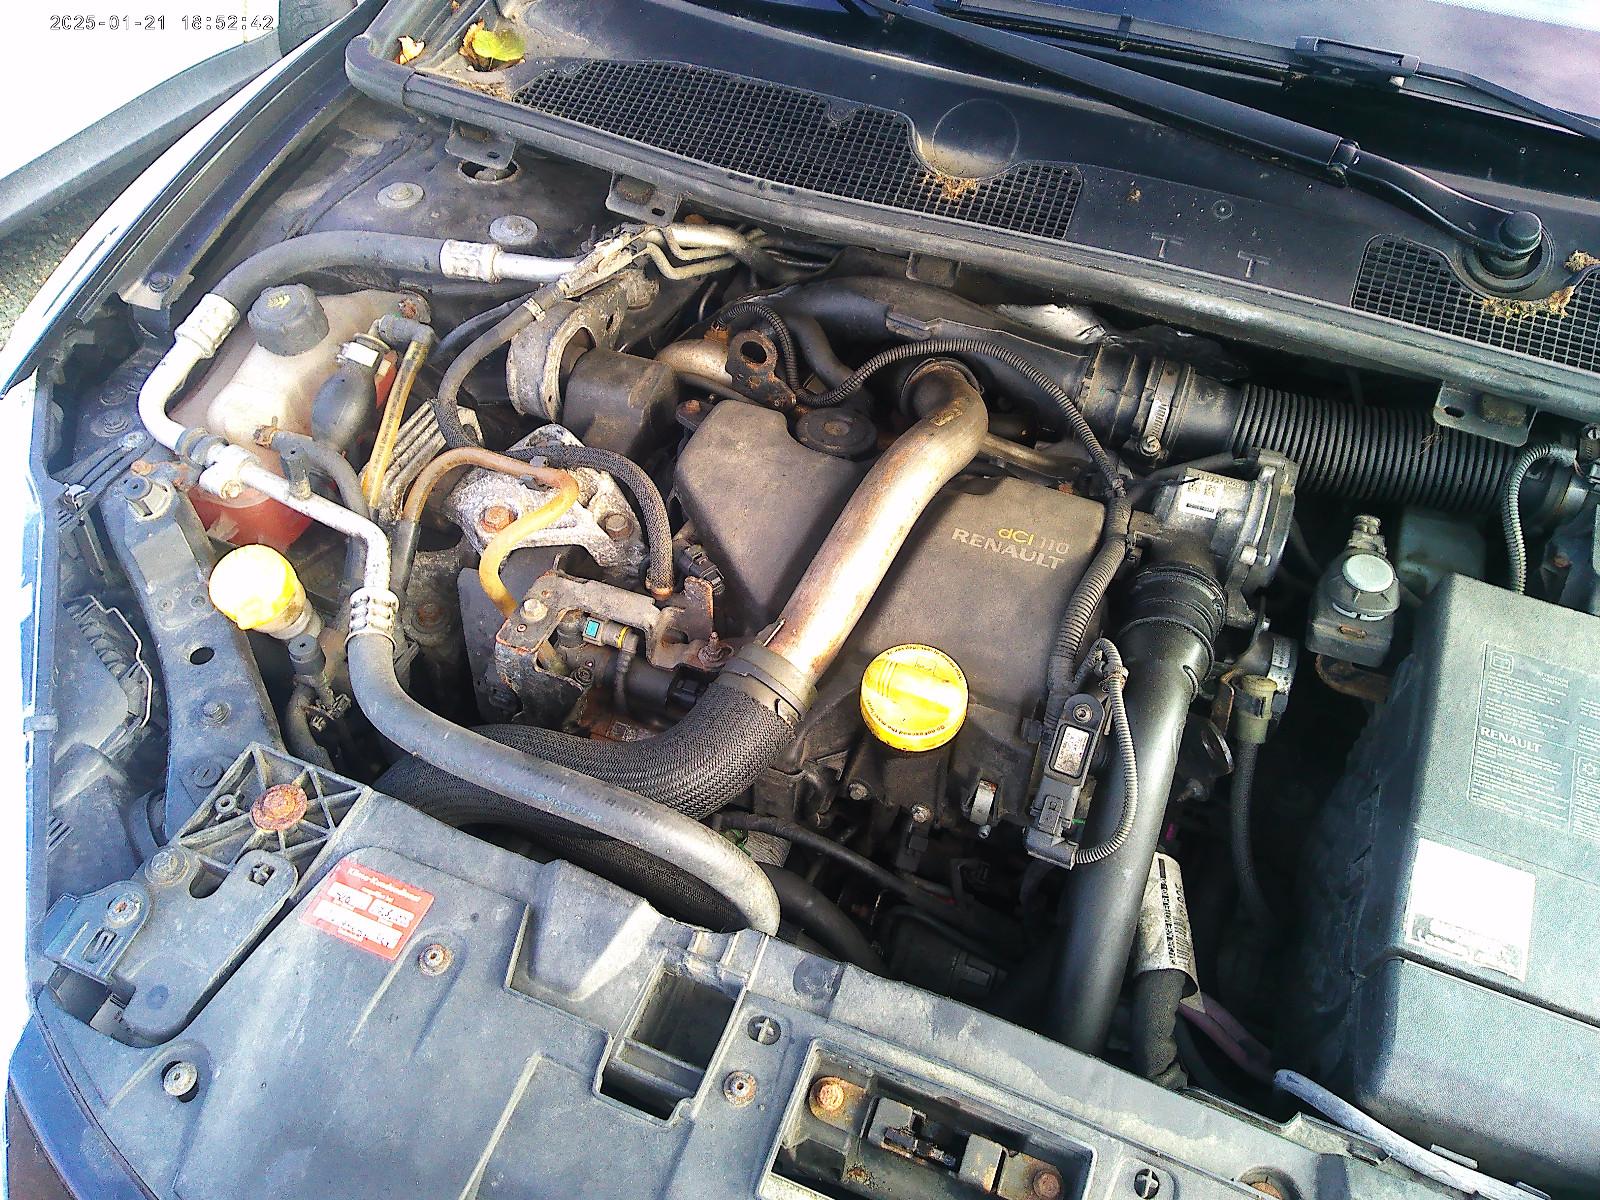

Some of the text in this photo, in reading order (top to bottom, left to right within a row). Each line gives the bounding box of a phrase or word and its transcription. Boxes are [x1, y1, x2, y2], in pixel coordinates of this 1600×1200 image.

[951, 527, 1065, 571] RENAULT
[1039, 536, 1070, 555] 110
[1480, 726, 1543, 754] RENAULT
